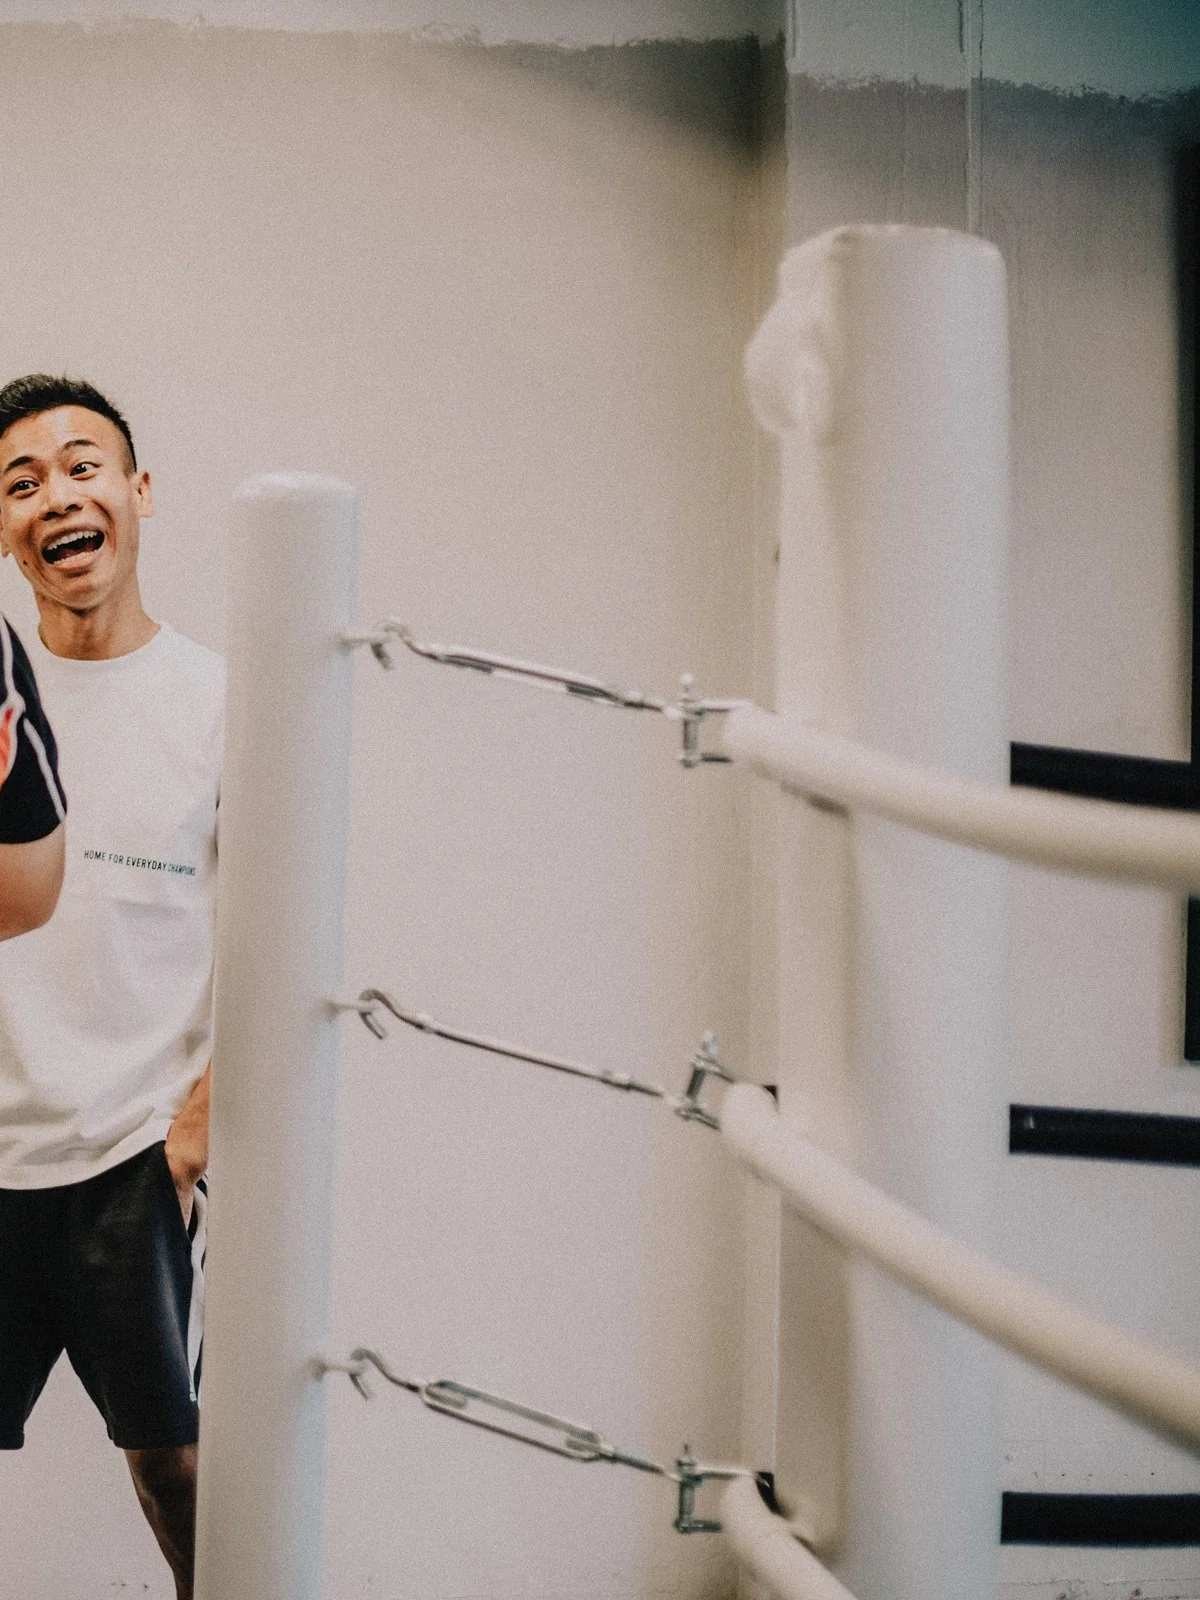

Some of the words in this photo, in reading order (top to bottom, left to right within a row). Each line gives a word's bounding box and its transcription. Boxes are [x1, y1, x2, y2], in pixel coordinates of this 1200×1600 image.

[84, 849, 106, 861] HOME
[108, 853, 123, 865] FOR
[126, 856, 168, 872] EVERYDAY
